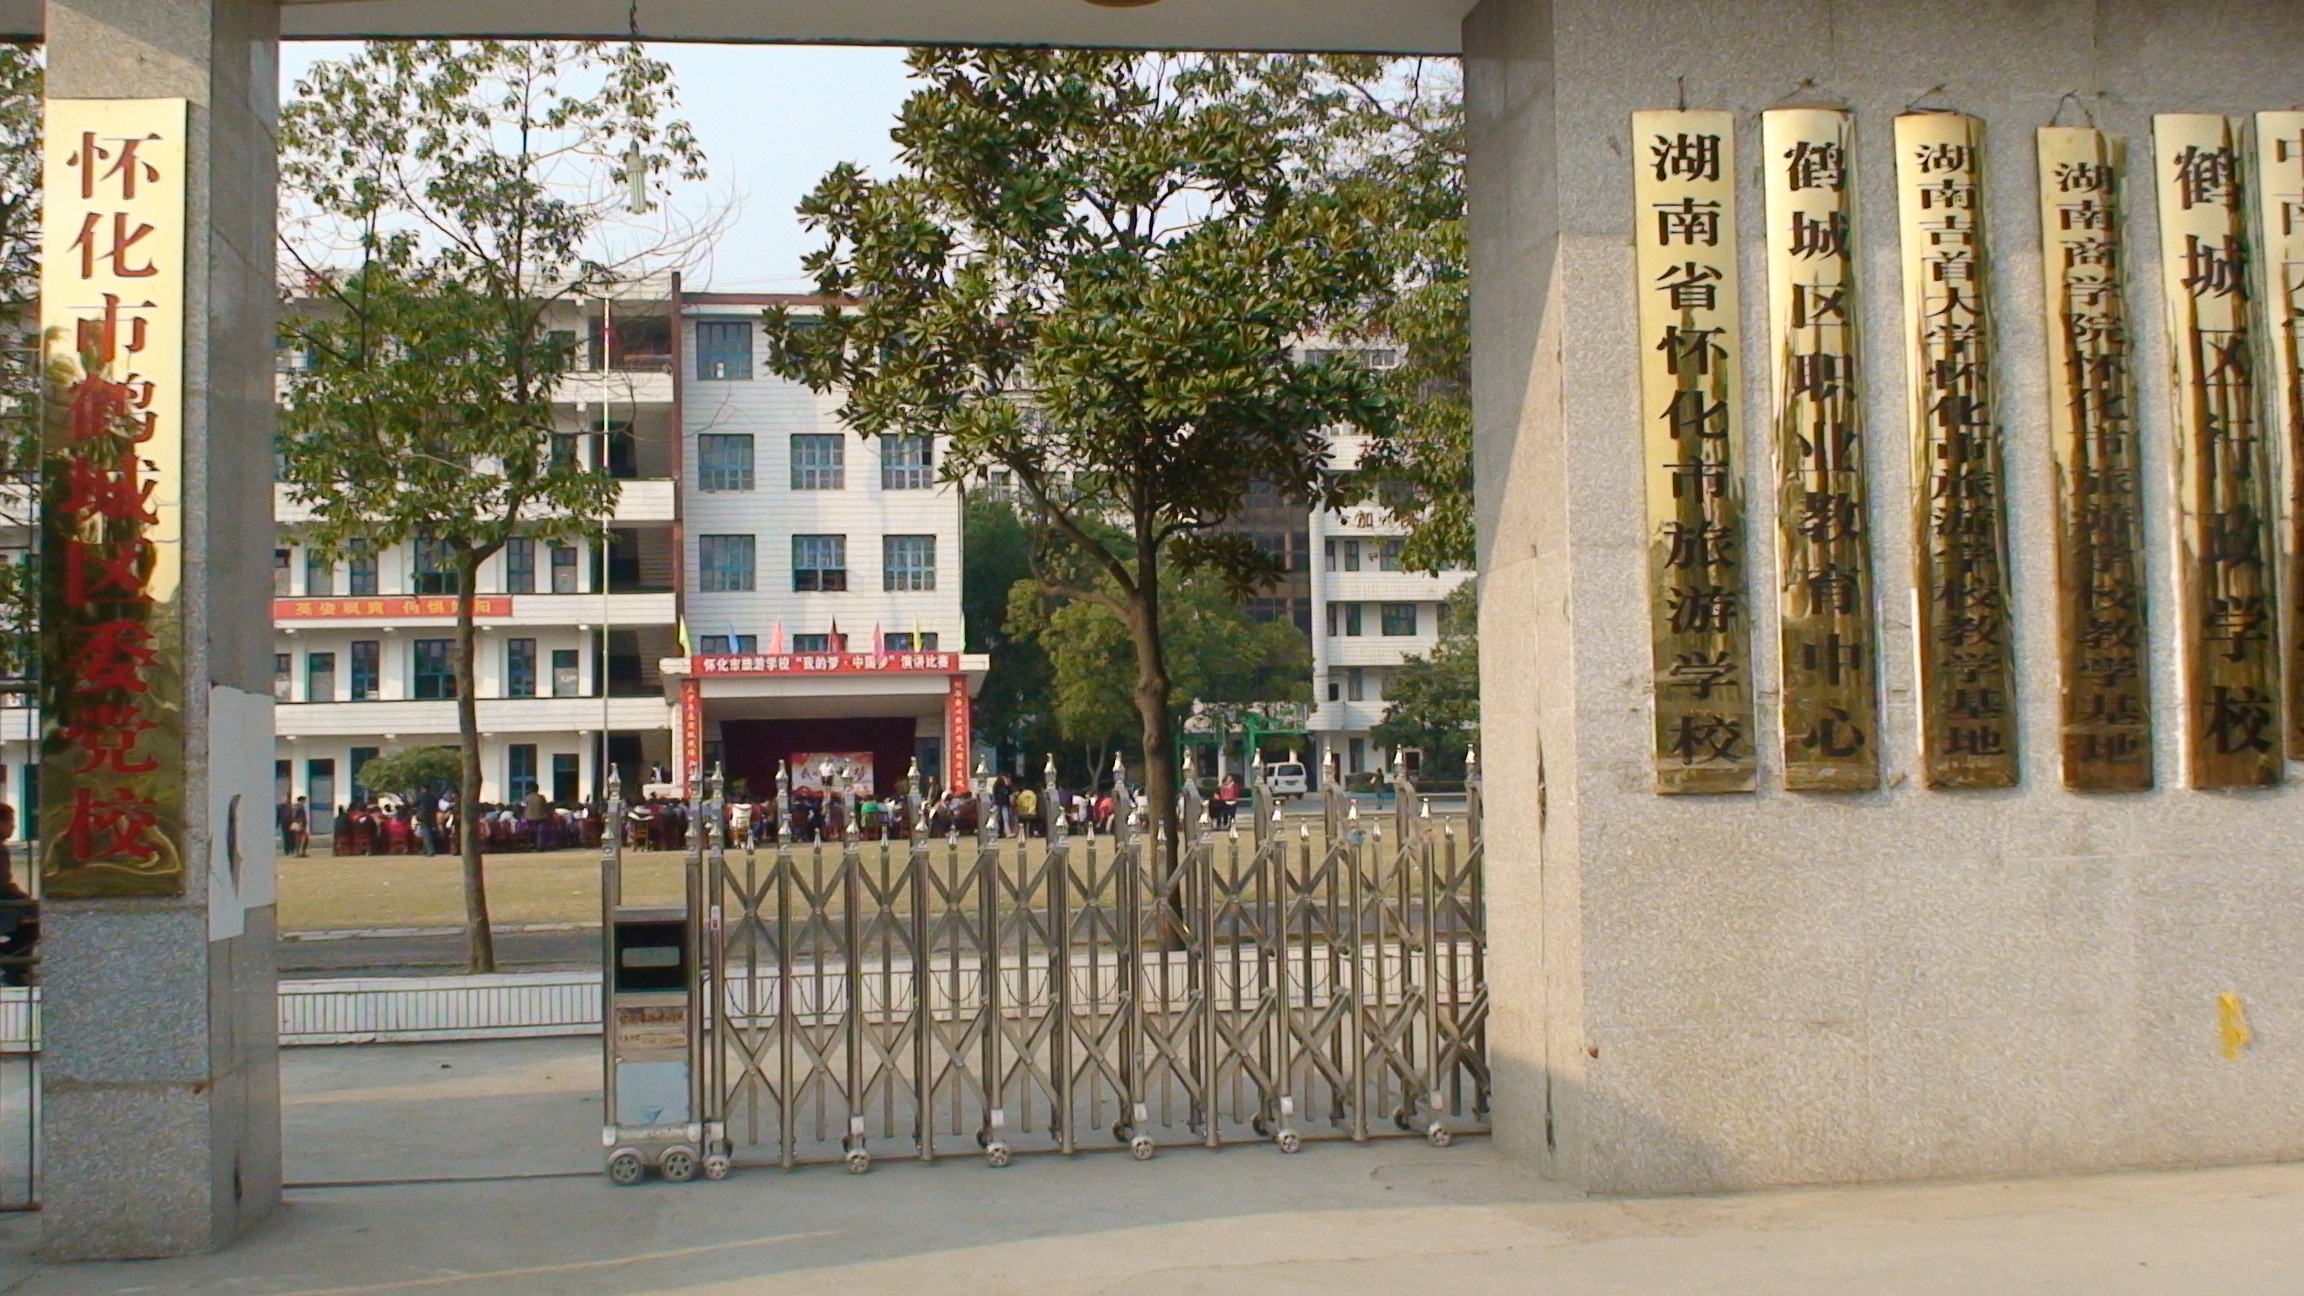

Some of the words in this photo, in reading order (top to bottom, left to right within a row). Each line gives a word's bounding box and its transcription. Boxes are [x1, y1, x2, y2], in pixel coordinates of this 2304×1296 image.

[62, 131, 164, 860] 怀化市鹤城区委党校
[1650, 133, 1742, 764] 湖南省怀化市旅游学校
[1783, 140, 1866, 760] 鹤城区职业教育中心
[1913, 142, 2008, 758] 湖南吉首大学怀化市旅游学校教学基地
[2053, 161, 2140, 764] 湖南商学院怀化市旅游学校教学基地
[2173, 145, 2272, 754] 鹤城区行政学校
